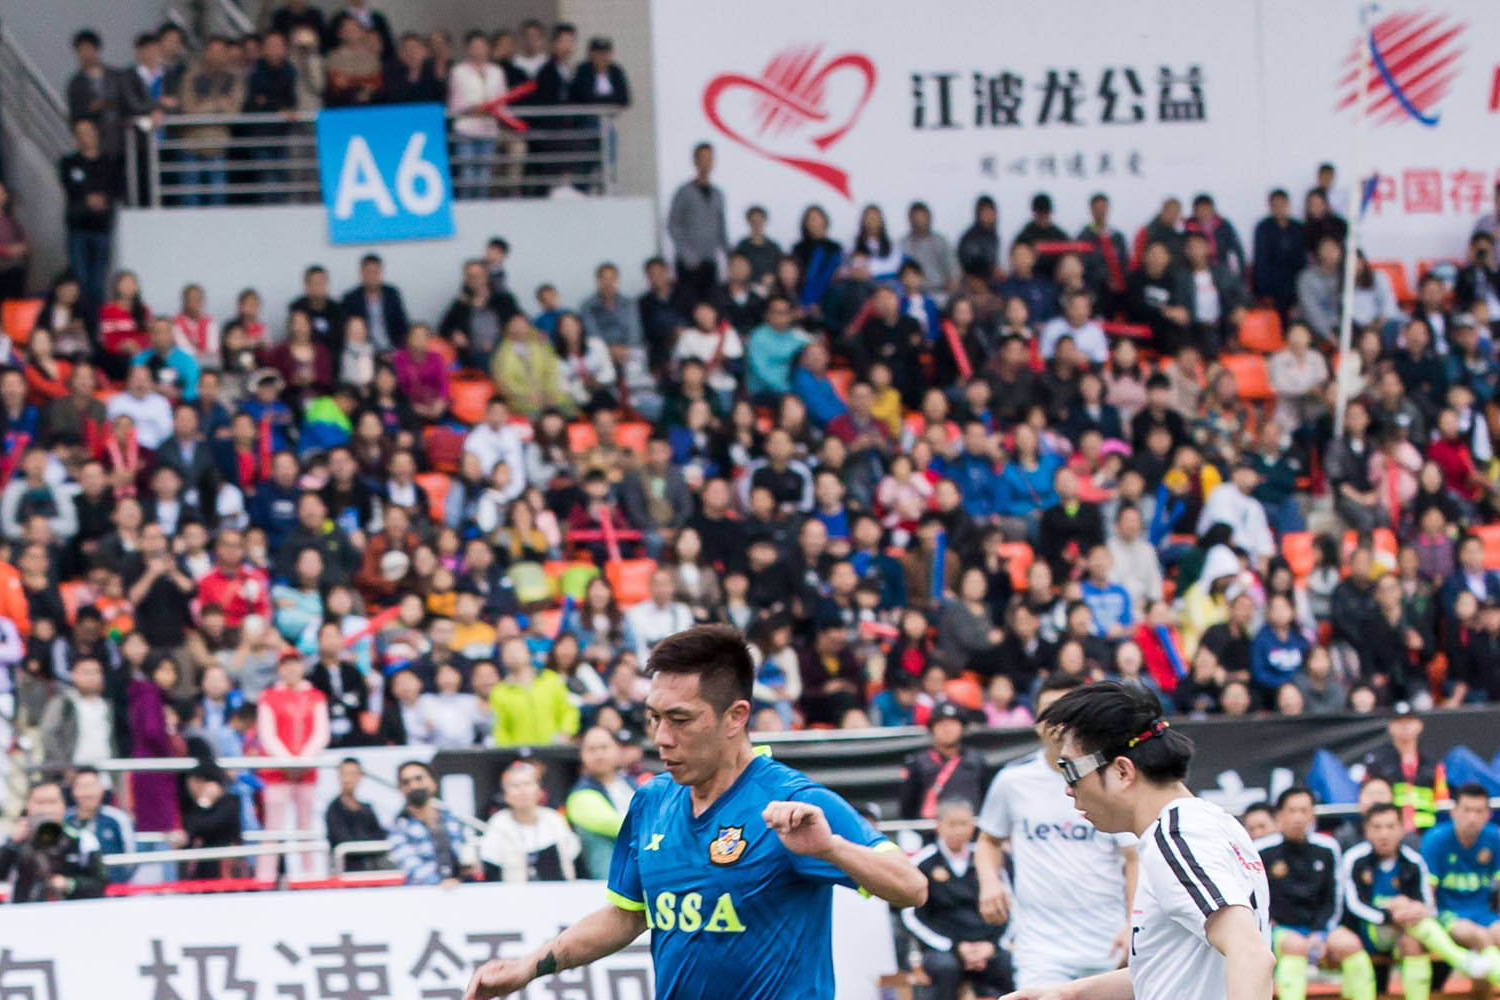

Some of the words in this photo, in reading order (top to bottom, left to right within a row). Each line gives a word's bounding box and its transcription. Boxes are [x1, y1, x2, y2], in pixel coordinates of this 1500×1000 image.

[909, 66, 1207, 129] 江波龙公益
[334, 131, 445, 220] A6
[1360, 165, 1500, 217] 中国存
